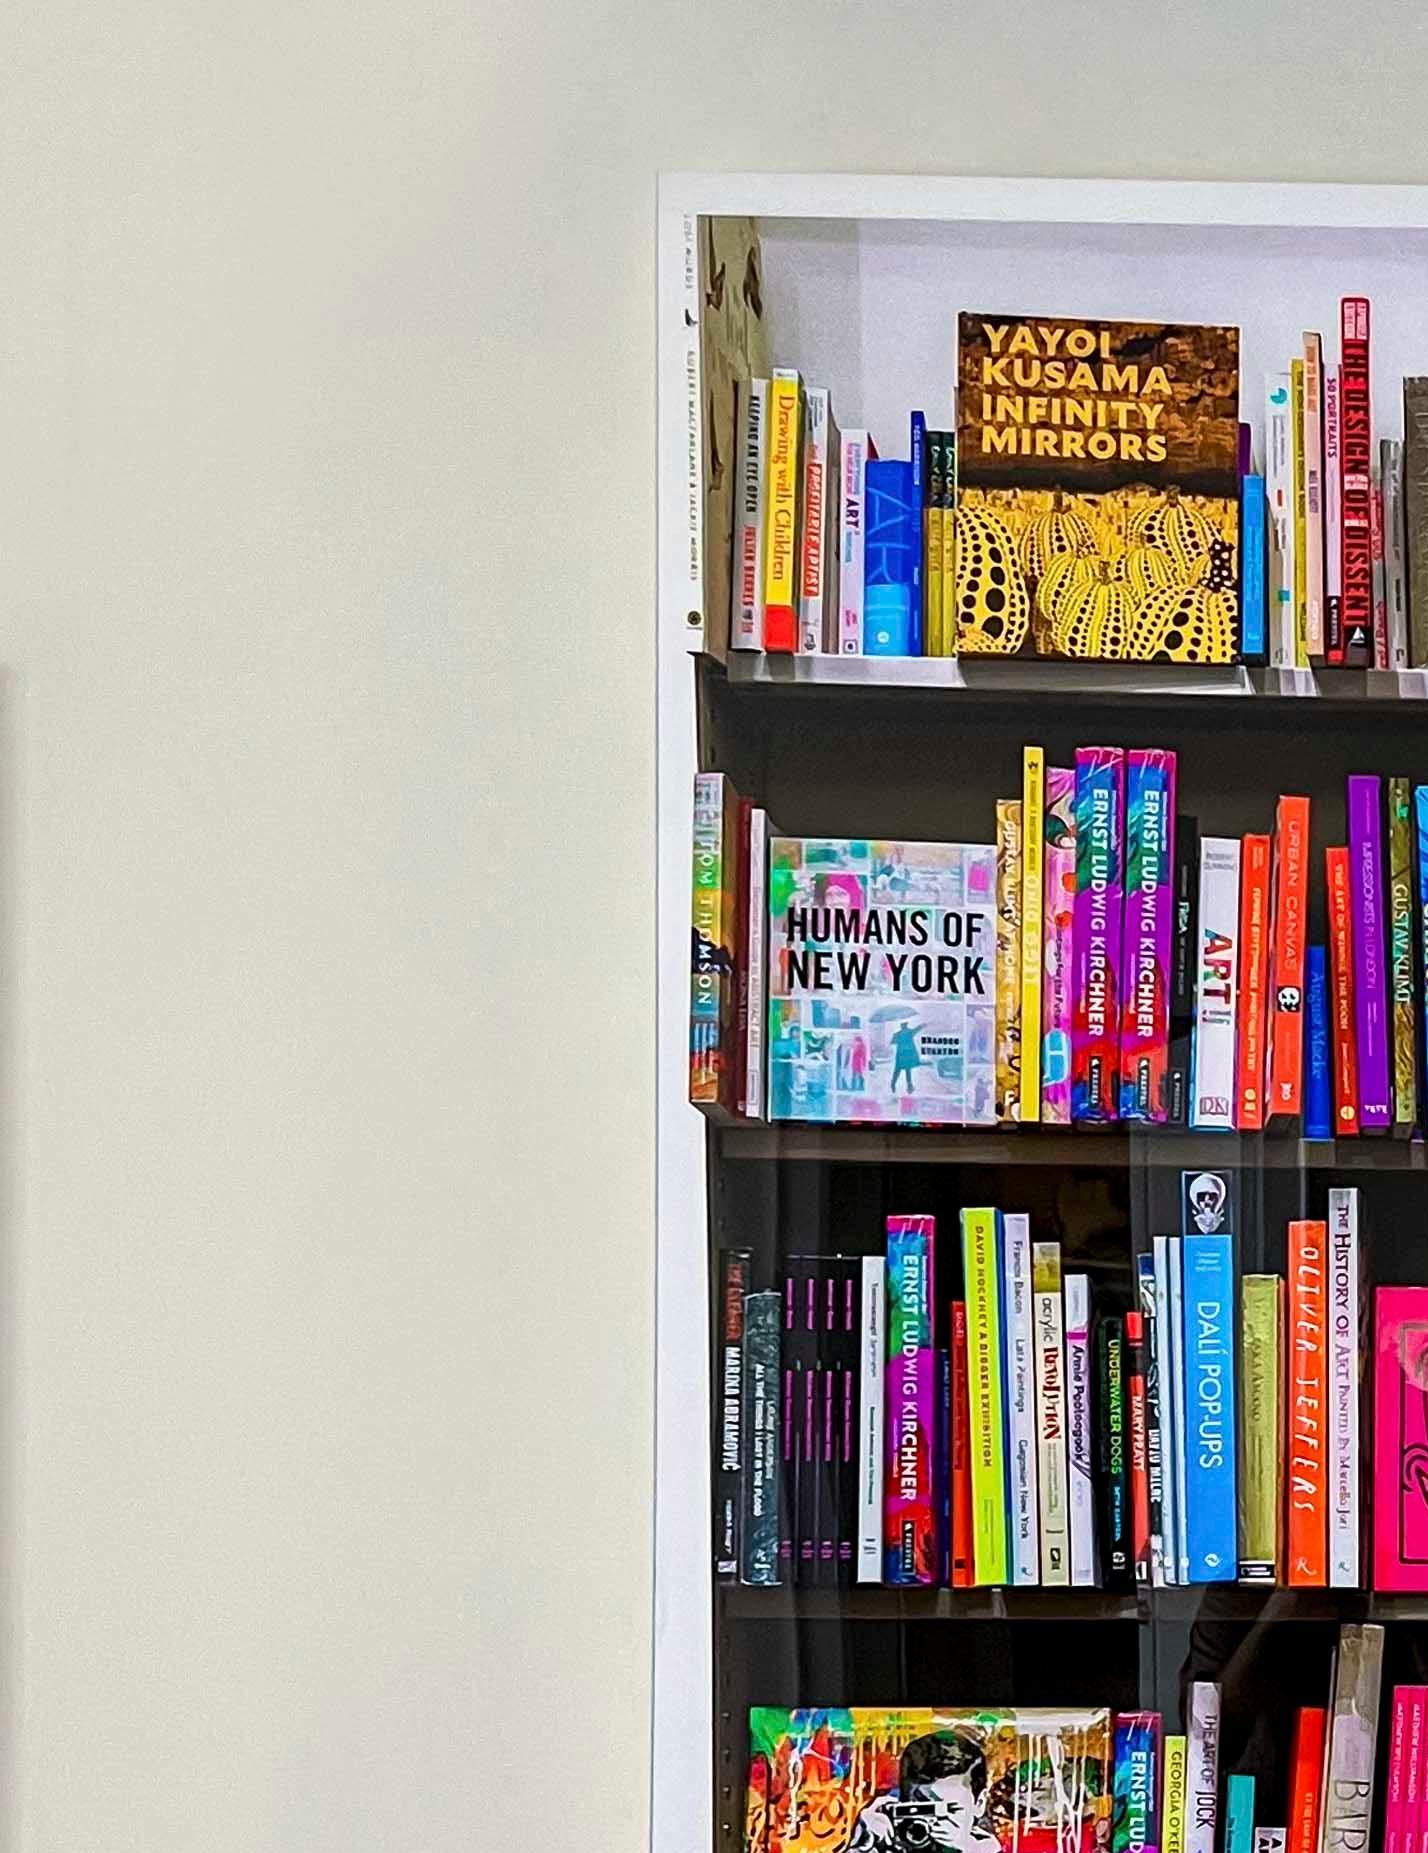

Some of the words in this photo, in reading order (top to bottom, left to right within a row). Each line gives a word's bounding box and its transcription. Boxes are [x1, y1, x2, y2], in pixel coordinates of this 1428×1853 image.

[982, 324, 1109, 358] YAYOI
[983, 357, 1171, 395] KUSAMA
[1326, 378, 1337, 392] 50
[748, 395, 760, 440] KEEPING
[773, 395, 795, 464] Drawing
[982, 394, 1165, 430] INFINITY
[1326, 394, 1337, 458] PORTRAITS
[748, 444, 759, 458] AN
[982, 427, 1168, 462] MIRRORS
[747, 462, 758, 481] EYE
[775, 469, 793, 504] with
[745, 486, 757, 513] OPEN
[845, 497, 860, 528] ART
[773, 510, 792, 580] Children
[1092, 788, 1108, 850] ERNST
[1143, 789, 1159, 851] ERNST
[698, 843, 713, 886] TOM
[1287, 820, 1300, 886] URBAN
[1090, 855, 1107, 930] LUDWIG
[1141, 856, 1157, 932] LUDWIG
[786, 907, 929, 945] HUMANS
[942, 912, 986, 948] OF
[1285, 895, 1299, 970] CANVAS
[1392, 884, 1411, 948] GUSTAV
[698, 899, 713, 1004] THOMSON
[787, 951, 870, 992] NEW
[887, 952, 986, 996] YORK
[1088, 936, 1106, 1036] KIRCHNER
[1137, 938, 1156, 1037] KIRCHNER
[1308, 970, 1325, 1025] August
[1394, 953, 1412, 1005] KLIMT
[1311, 1028, 1326, 1079] Macke
[1012, 1240, 1024, 1278] Francis
[1013, 1281, 1025, 1314] Bacon
[1039, 1297, 1057, 1342] acrylic
[1294, 1246, 1321, 1353] OLIVER
[1198, 1301, 1229, 1356] DALÍ
[723, 1347, 741, 1395] MARINA
[1042, 1346, 1061, 1440] REVOLUTION
[1107, 1339, 1122, 1432] UNDERWATER
[721, 1398, 741, 1471] ABRAMOVIĆ
[1131, 1395, 1144, 1434] MARY
[1198, 1364, 1222, 1469] POP-UPS
[1016, 1439, 1030, 1488] Gagosian
[1110, 1436, 1122, 1475] DOGS
[1133, 1434, 1145, 1472] PRATT
[1291, 1379, 1319, 1512] JEFFERS
[1019, 1490, 1030, 1513] New
[1020, 1515, 1031, 1539] York
[1203, 1713, 1217, 1739] THE
[1201, 1740, 1216, 1766] ART
[1201, 1767, 1215, 1785] OF
[1194, 1790, 1216, 1830] JOCK
[1270, 1838, 1282, 1849] A
